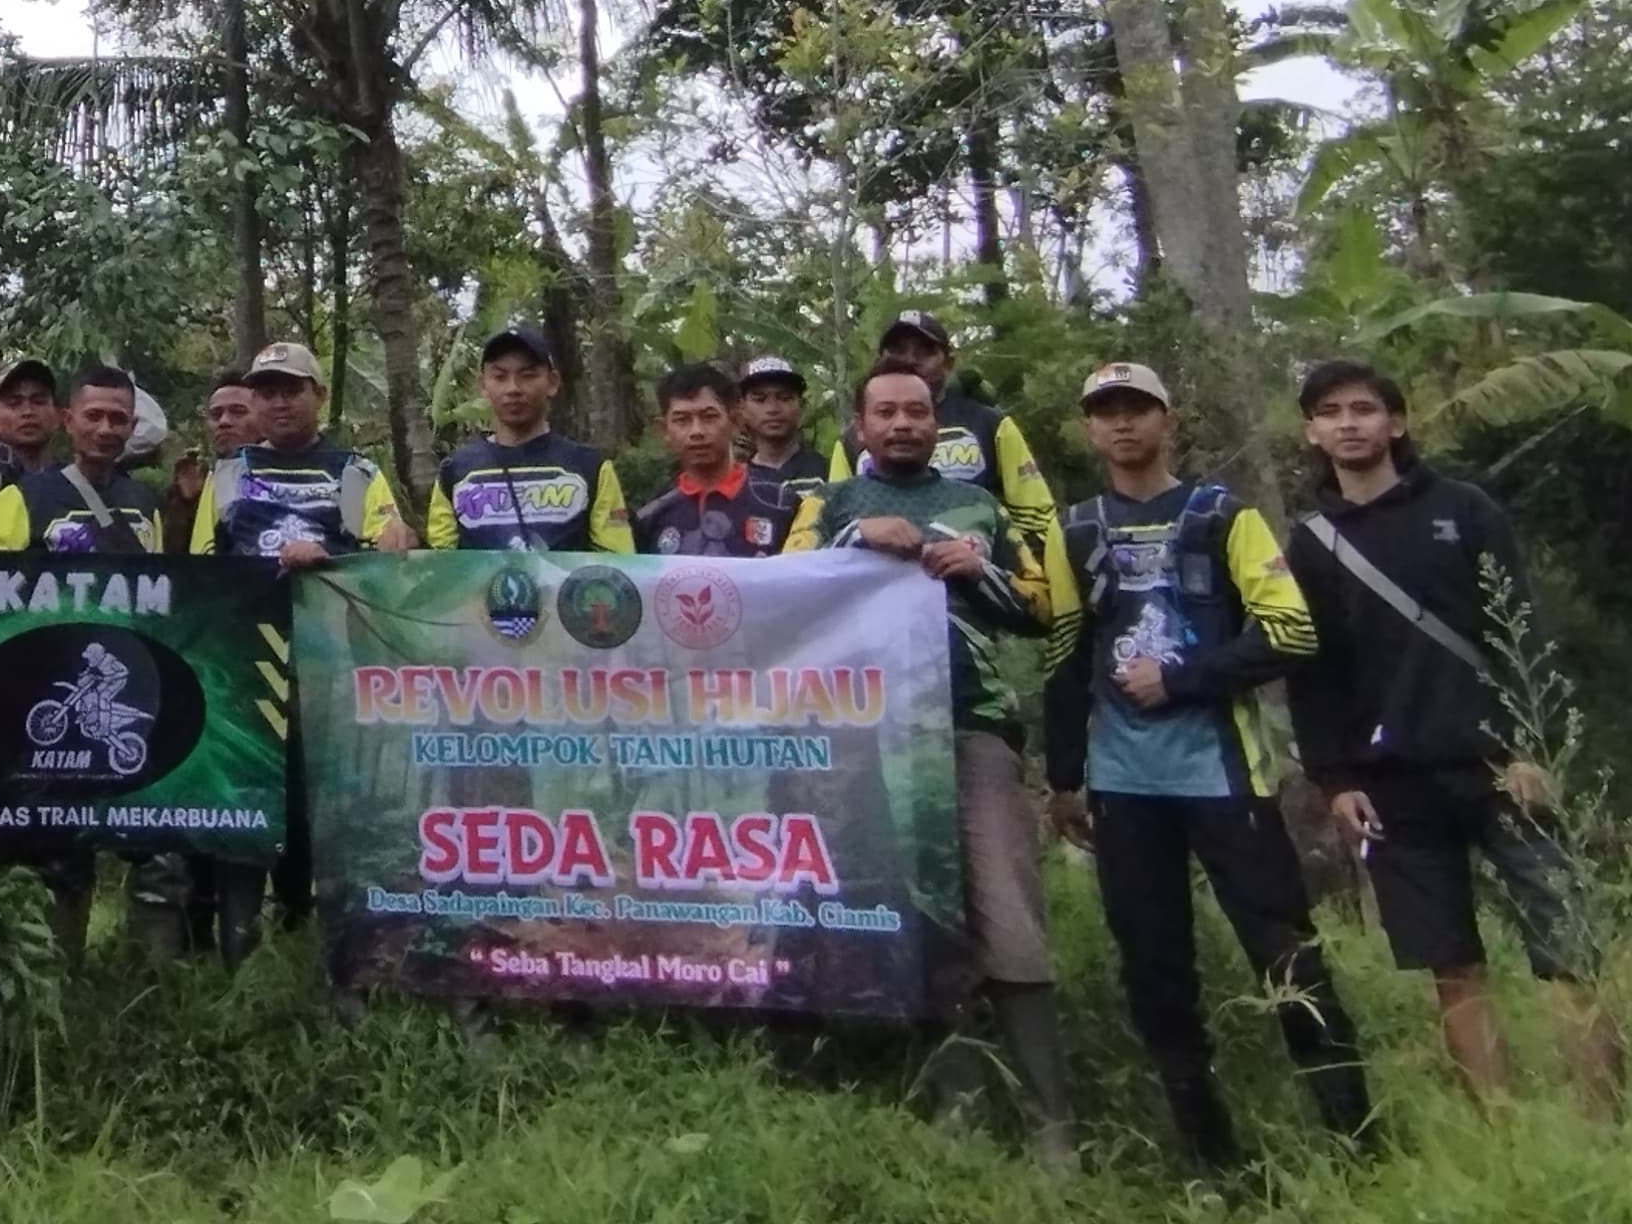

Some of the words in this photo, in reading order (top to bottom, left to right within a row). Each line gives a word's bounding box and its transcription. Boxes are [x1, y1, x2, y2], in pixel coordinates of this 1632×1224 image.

[354, 667, 666, 724] REVOLUSI
[688, 667, 884, 725] HIJAU
[31, 750, 92, 769] KATAM
[414, 734, 601, 766] KELOMPOK
[611, 735, 695, 768] TANI
[704, 736, 831, 769] HUTAN
[37, 807, 98, 827] TRAIL
[105, 808, 268, 829] MEKARBUANA
[419, 809, 613, 885] SEDA
[632, 812, 838, 892] RASA
[369, 888, 420, 911] Desa
[423, 890, 560, 919] Sadapaingan
[563, 895, 611, 918] Kec.
[615, 896, 756, 927] Panawangan
[761, 899, 814, 925] Kab.
[819, 903, 900, 931] Ciamis
[491, 949, 549, 974] Seba
[556, 952, 649, 983] Tangkal
[657, 955, 722, 980] Moro
[728, 959, 767, 983] Cai
